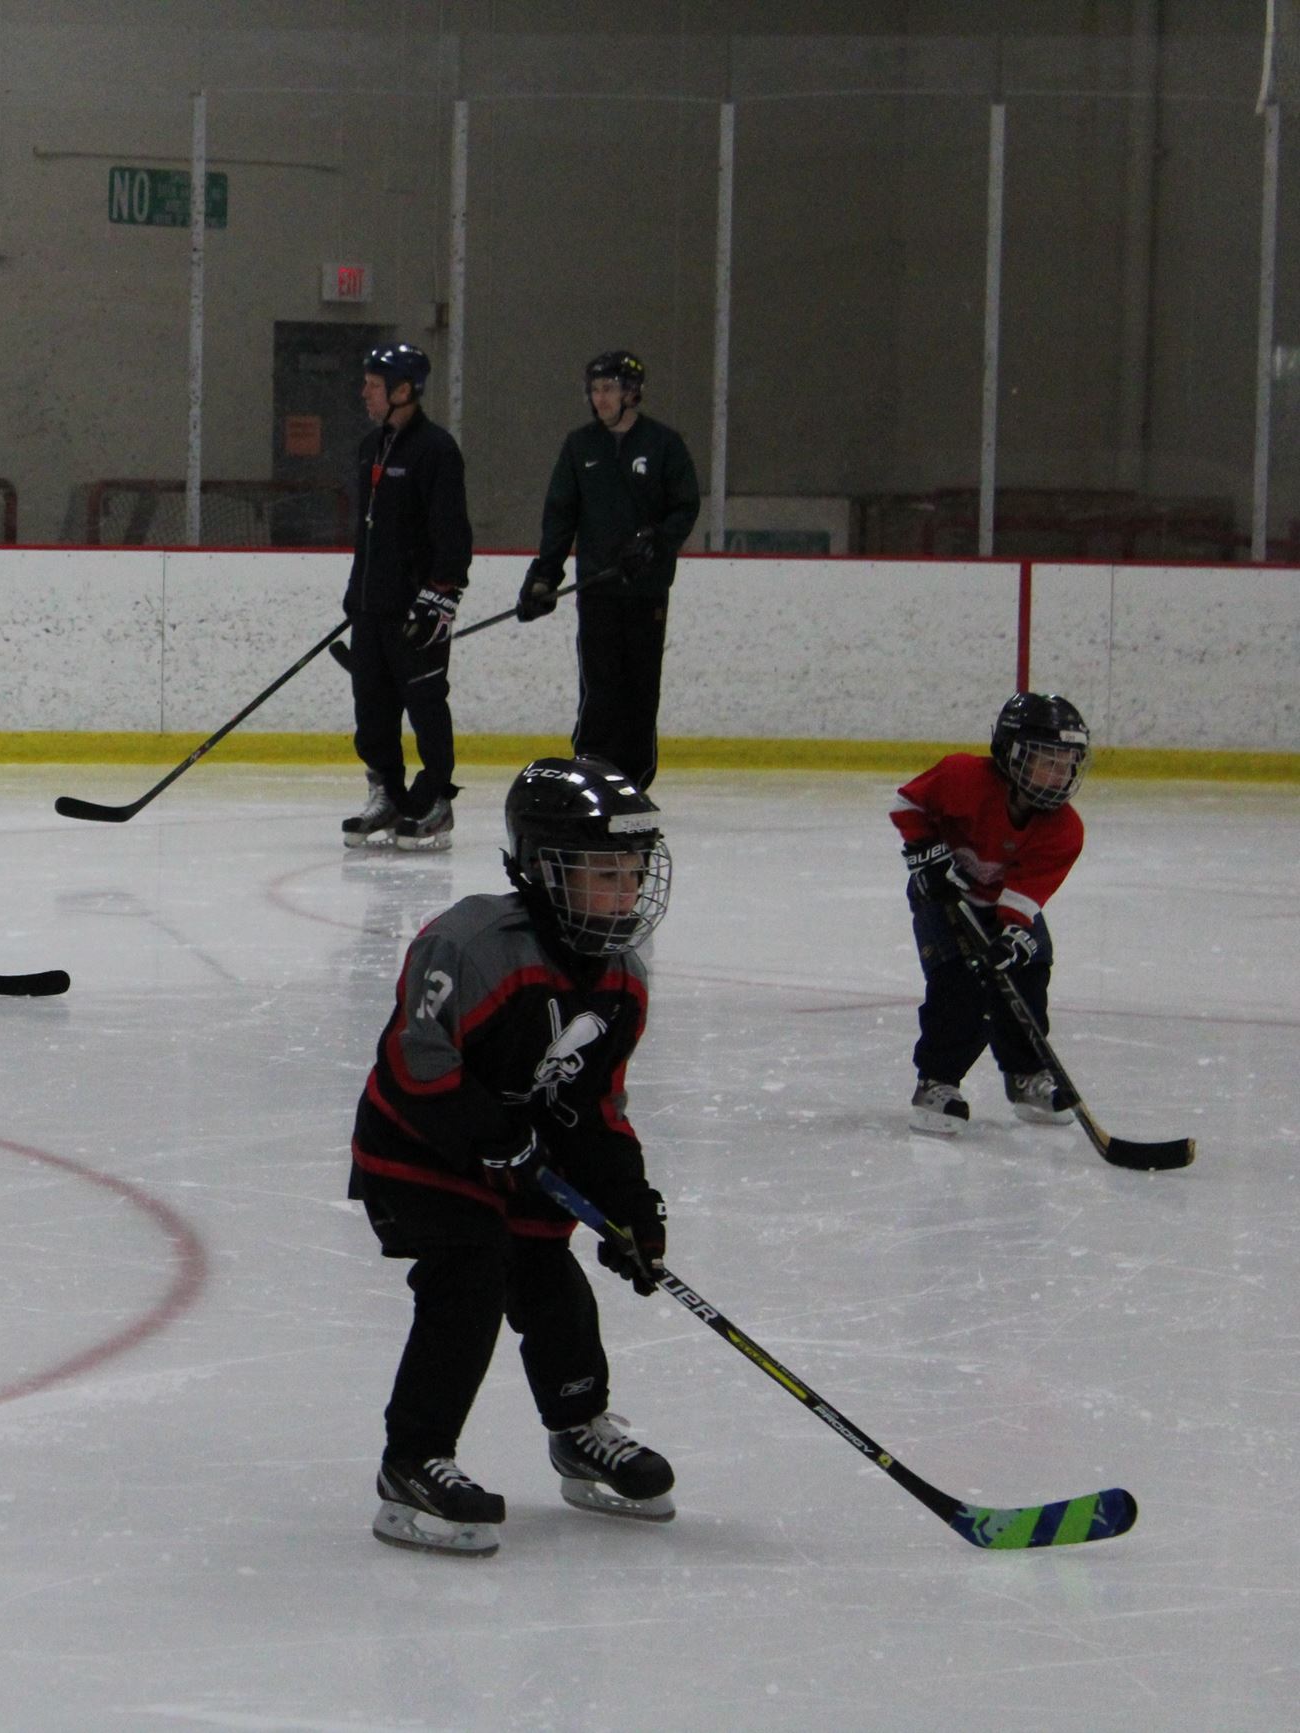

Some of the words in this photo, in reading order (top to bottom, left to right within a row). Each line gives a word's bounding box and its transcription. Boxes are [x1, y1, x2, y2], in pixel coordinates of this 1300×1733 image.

[111, 170, 150, 222] NO
[338, 267, 365, 298] EXIT
[812, 1405, 876, 1453] PRODIGY
